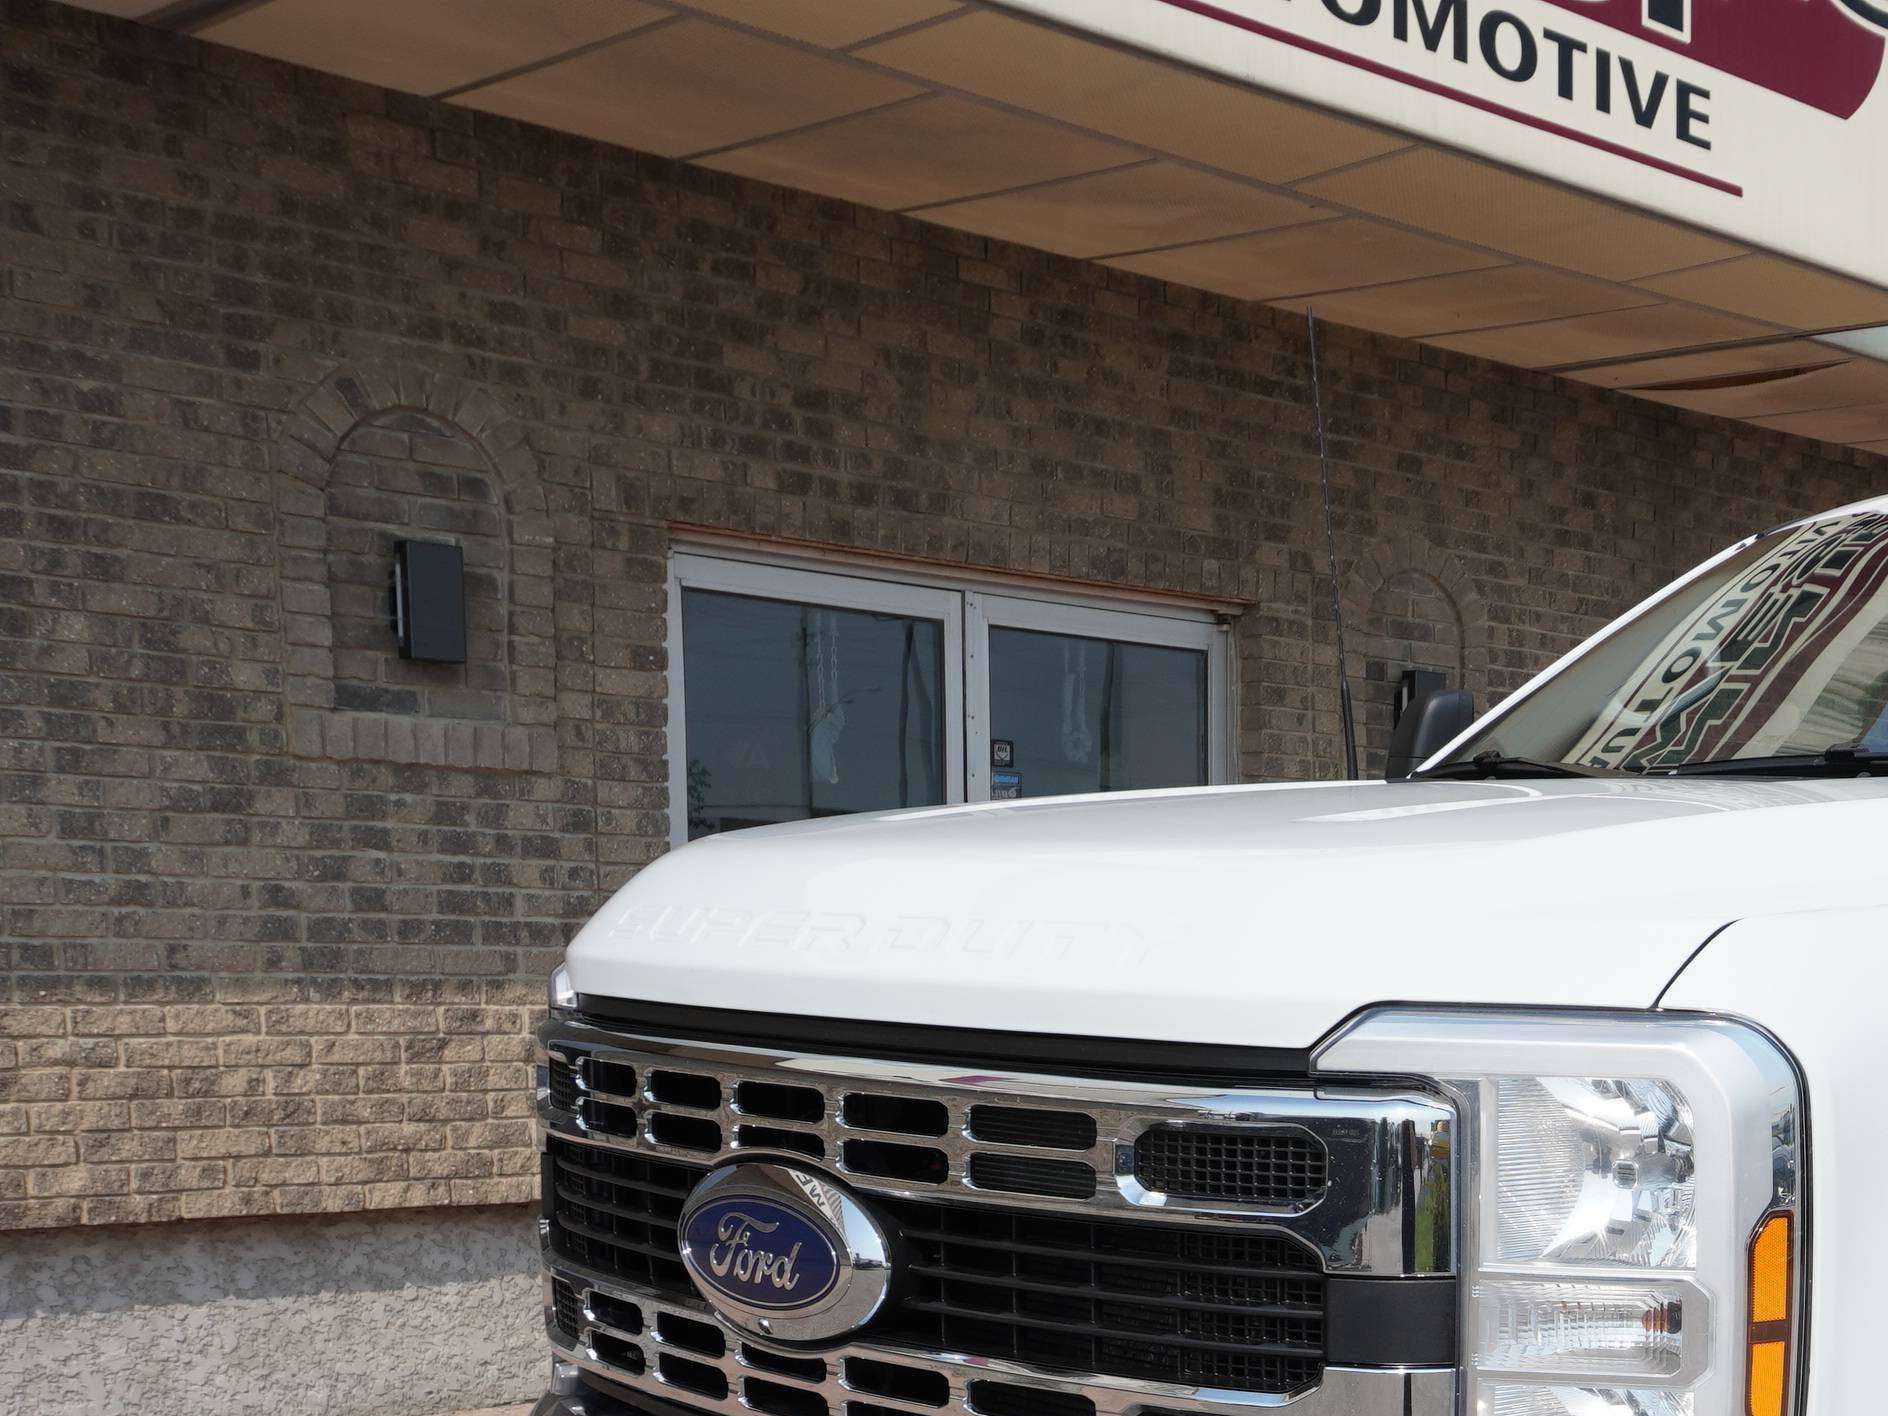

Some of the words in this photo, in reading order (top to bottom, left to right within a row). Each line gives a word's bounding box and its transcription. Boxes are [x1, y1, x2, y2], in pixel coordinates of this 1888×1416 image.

[1327, 0, 1712, 150] MOTIVE
[607, 902, 870, 953] SUPER
[710, 1211, 800, 1291] Ford
